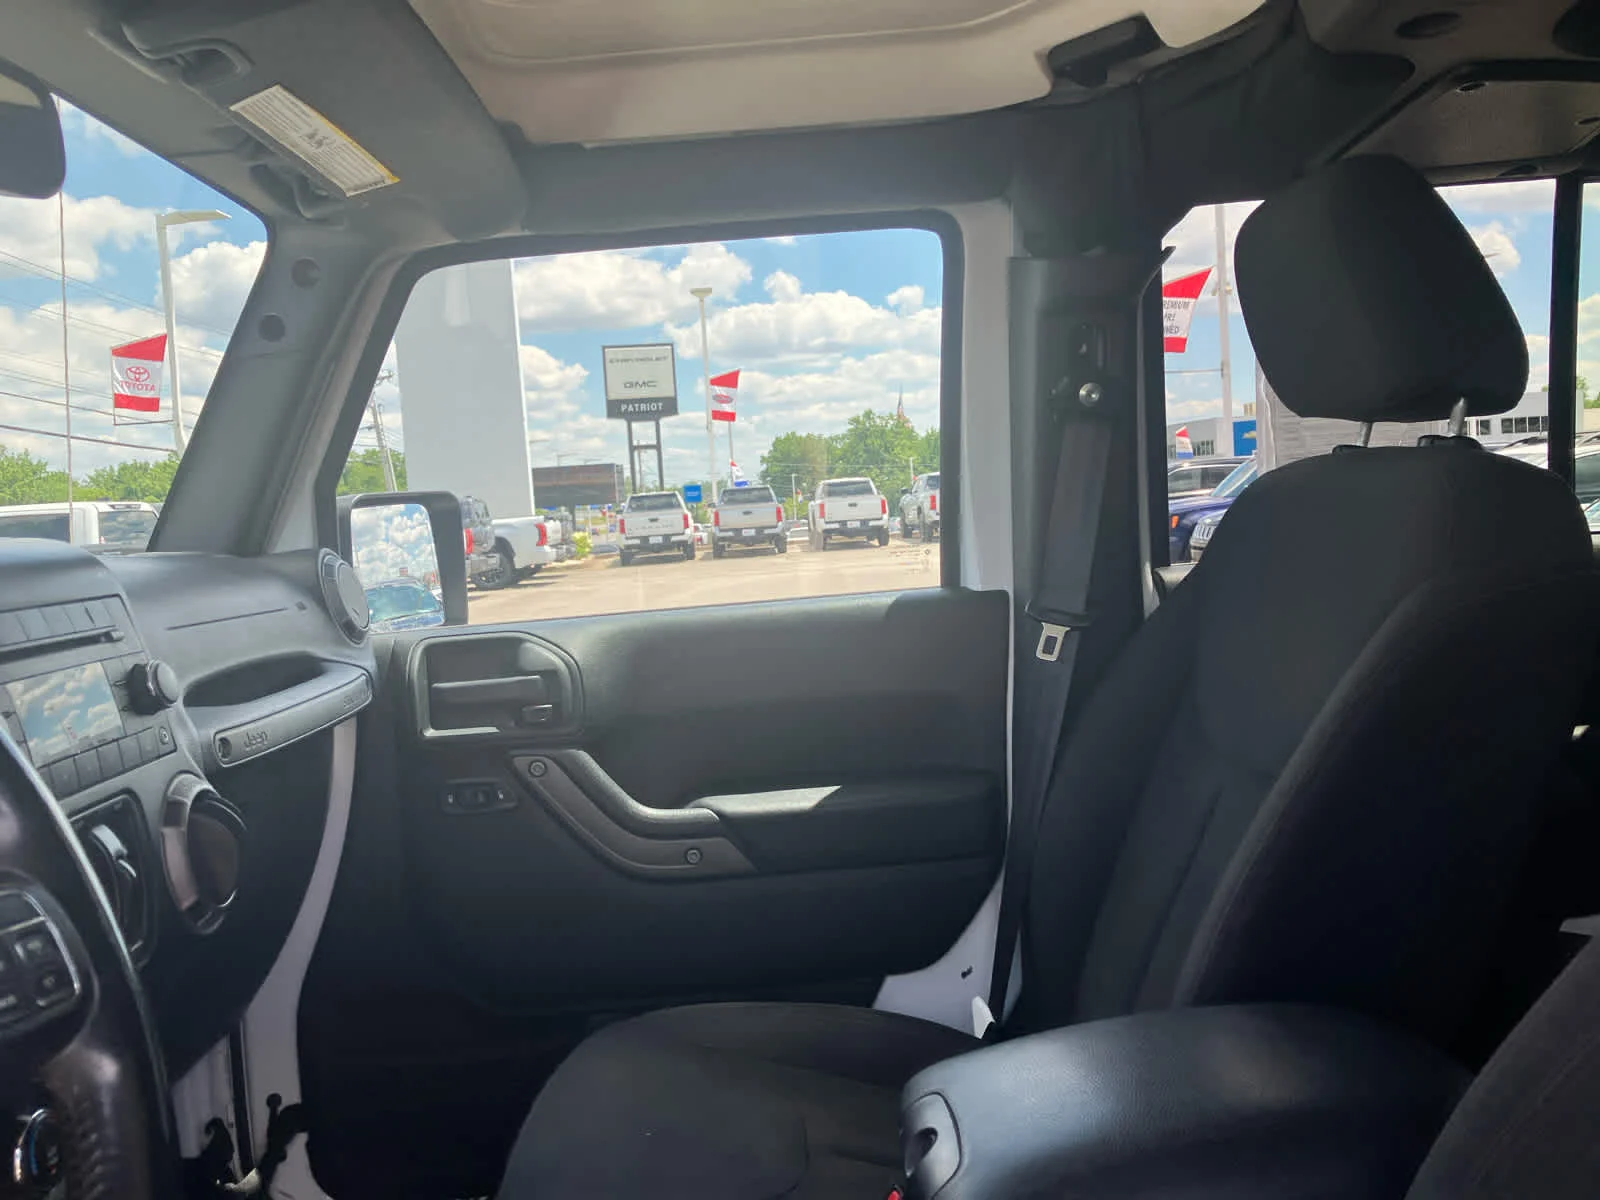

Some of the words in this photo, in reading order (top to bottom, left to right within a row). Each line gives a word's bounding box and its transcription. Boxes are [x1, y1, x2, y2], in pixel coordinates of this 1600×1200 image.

[120, 380, 156, 392] TOYOTA
[623, 380, 658, 389] GMC
[620, 402, 664, 413] PATRIOT
[243, 730, 269, 750] Jeep
